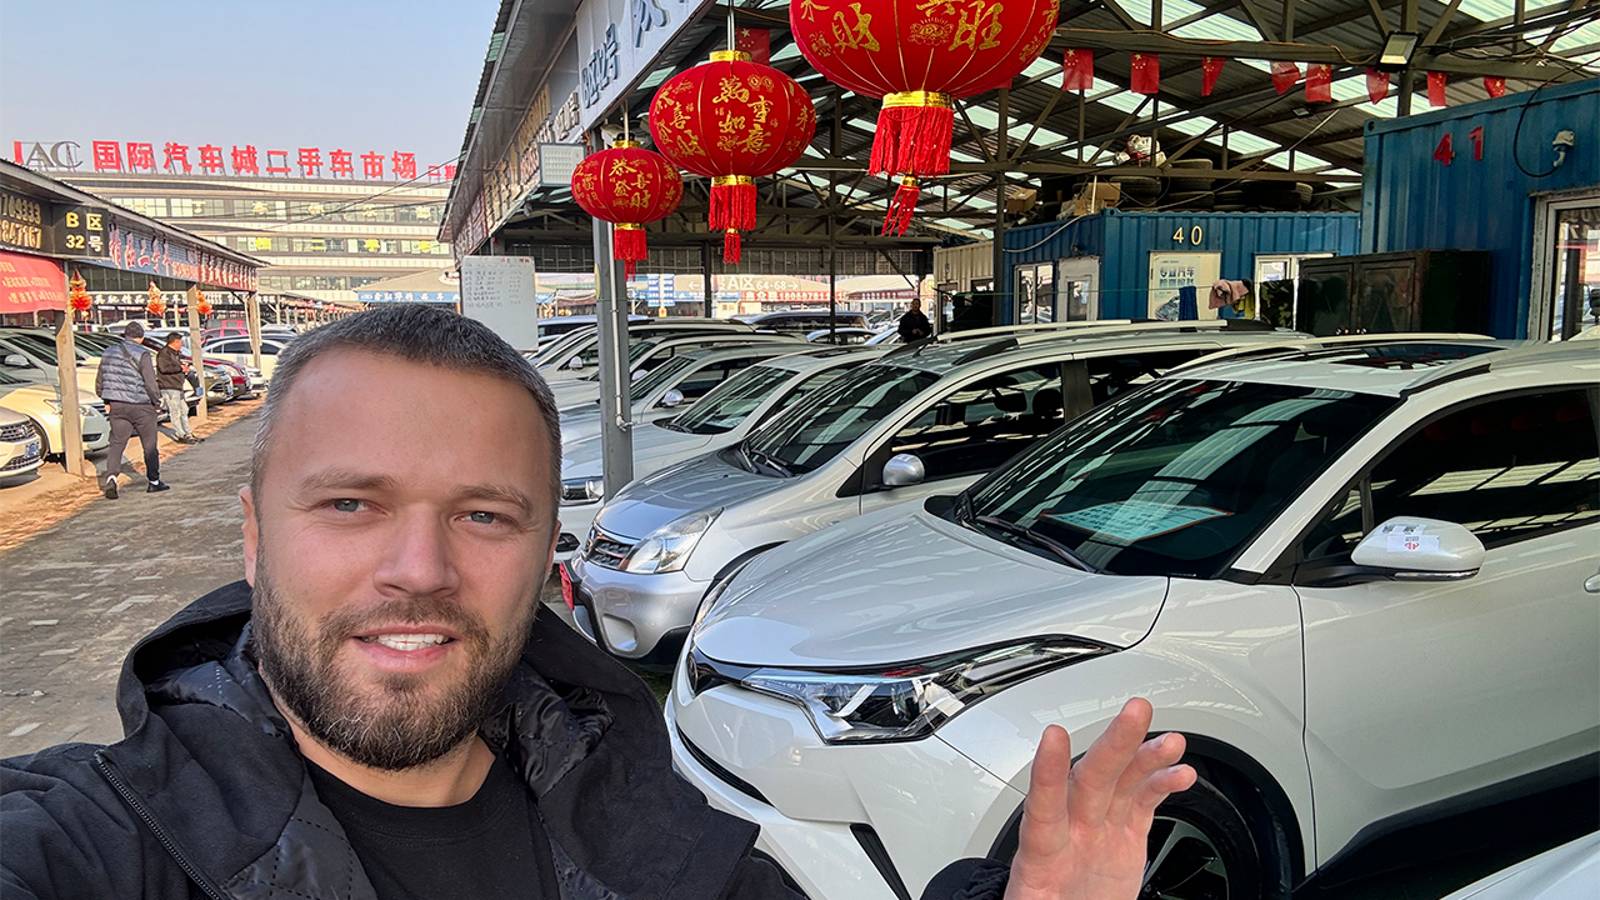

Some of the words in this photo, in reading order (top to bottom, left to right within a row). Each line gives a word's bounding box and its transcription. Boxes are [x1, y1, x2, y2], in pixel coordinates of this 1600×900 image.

[13, 139, 84, 169] IAC
[92, 139, 417, 180] 国际汽车城二手车市场
[1433, 126, 1484, 166] 41
[65, 234, 104, 252] 32号
[1173, 225, 1203, 245] 40
